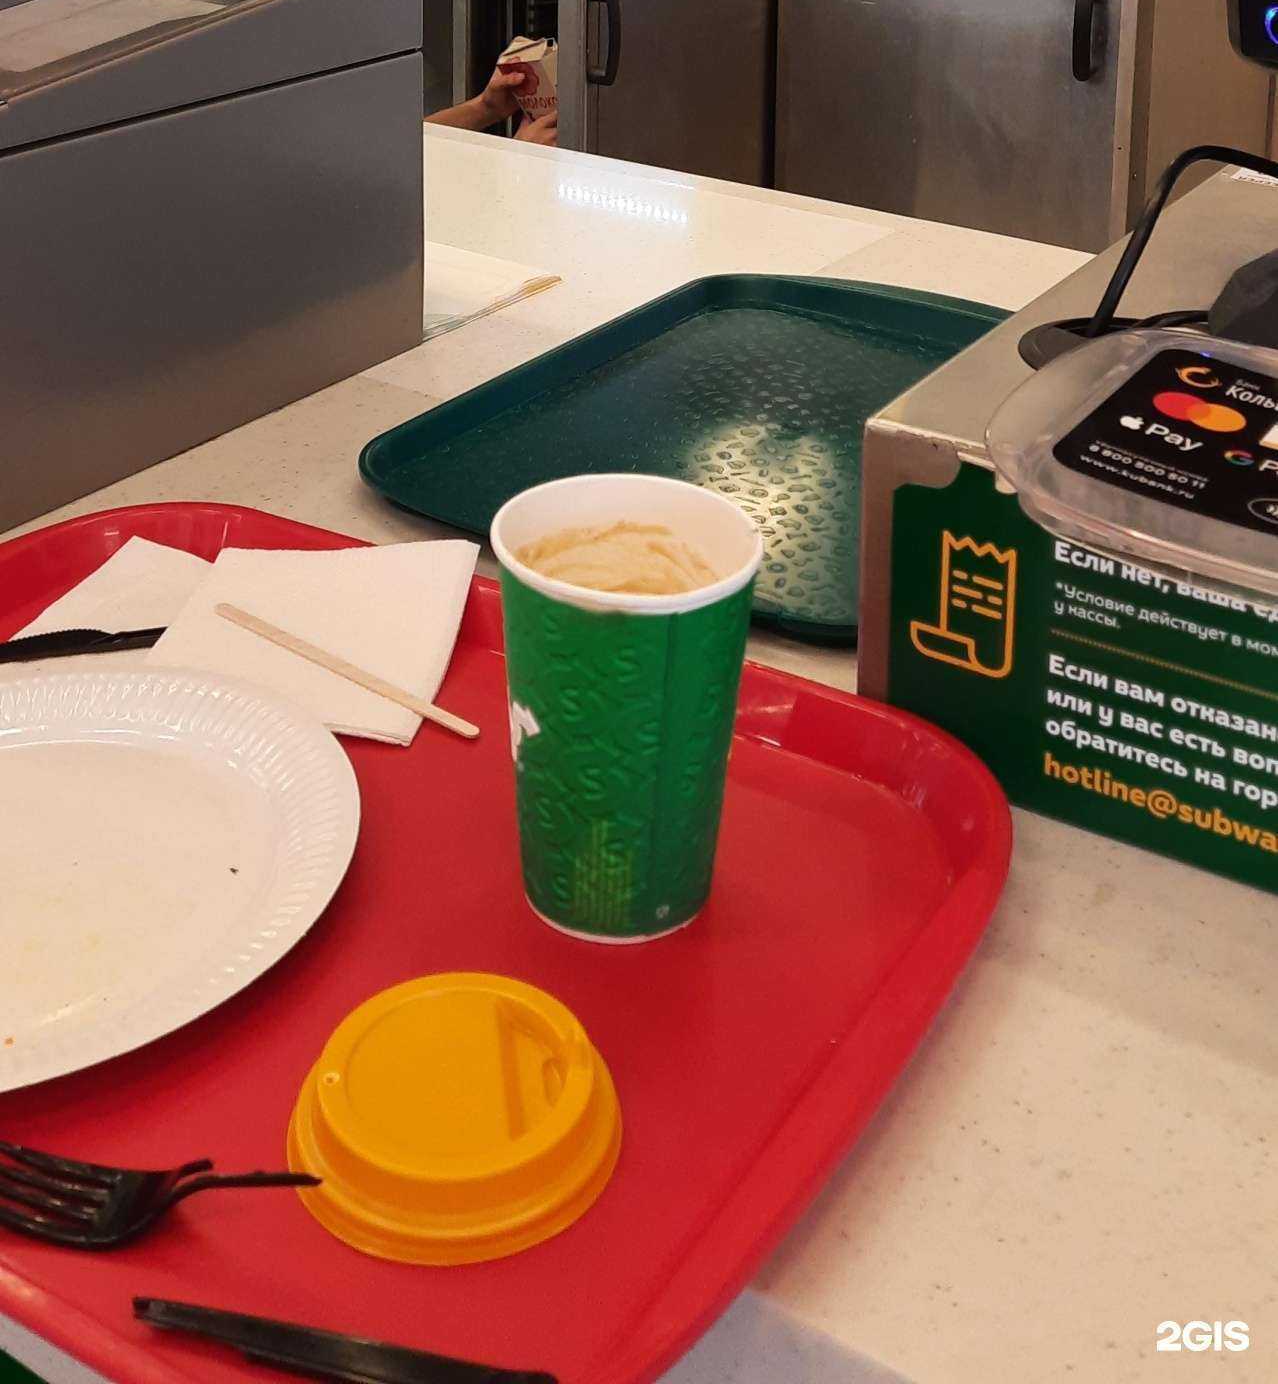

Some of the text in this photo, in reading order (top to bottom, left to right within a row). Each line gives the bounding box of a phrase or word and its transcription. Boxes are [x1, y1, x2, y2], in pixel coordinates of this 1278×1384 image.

[1226, 386, 1278, 411] Коль
[1145, 424, 1203, 452] Pay
[1054, 540, 1115, 576] Если
[1121, 564, 1170, 594] нет,
[1054, 600, 1065, 615] у
[1138, 608, 1227, 641] действует
[1231, 635, 1242, 647] в
[1047, 689, 1093, 716] или
[1099, 706, 1114, 727] у
[1120, 712, 1165, 739] вас
[1169, 728, 1226, 758] есть
[1048, 654, 1278, 742] Если вам отказан
[1046, 719, 1188, 778] обратитесь
[1195, 768, 1226, 791] на
[1044, 752, 1278, 854] hotline@subwa
